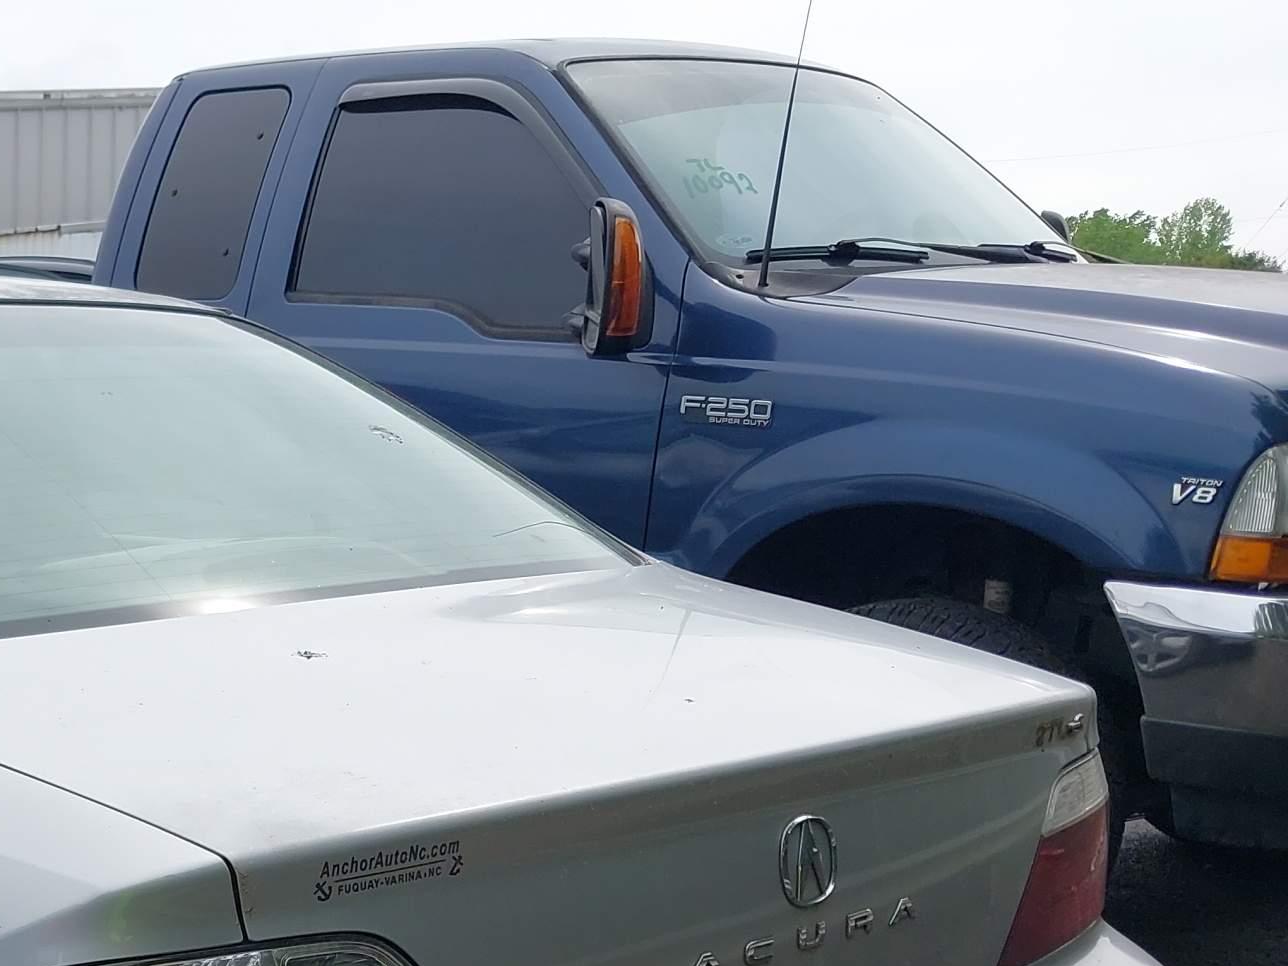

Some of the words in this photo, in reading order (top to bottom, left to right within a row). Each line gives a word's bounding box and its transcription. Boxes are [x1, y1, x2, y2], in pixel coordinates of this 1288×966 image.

[679, 395, 772, 420] F-250
[709, 416, 740, 425] SUPER
[743, 418, 770, 427] DUTY
[1181, 476, 1223, 487] TRITON
[1172, 483, 1217, 505] V8
[319, 840, 461, 879] AnchorAutoNc.com
